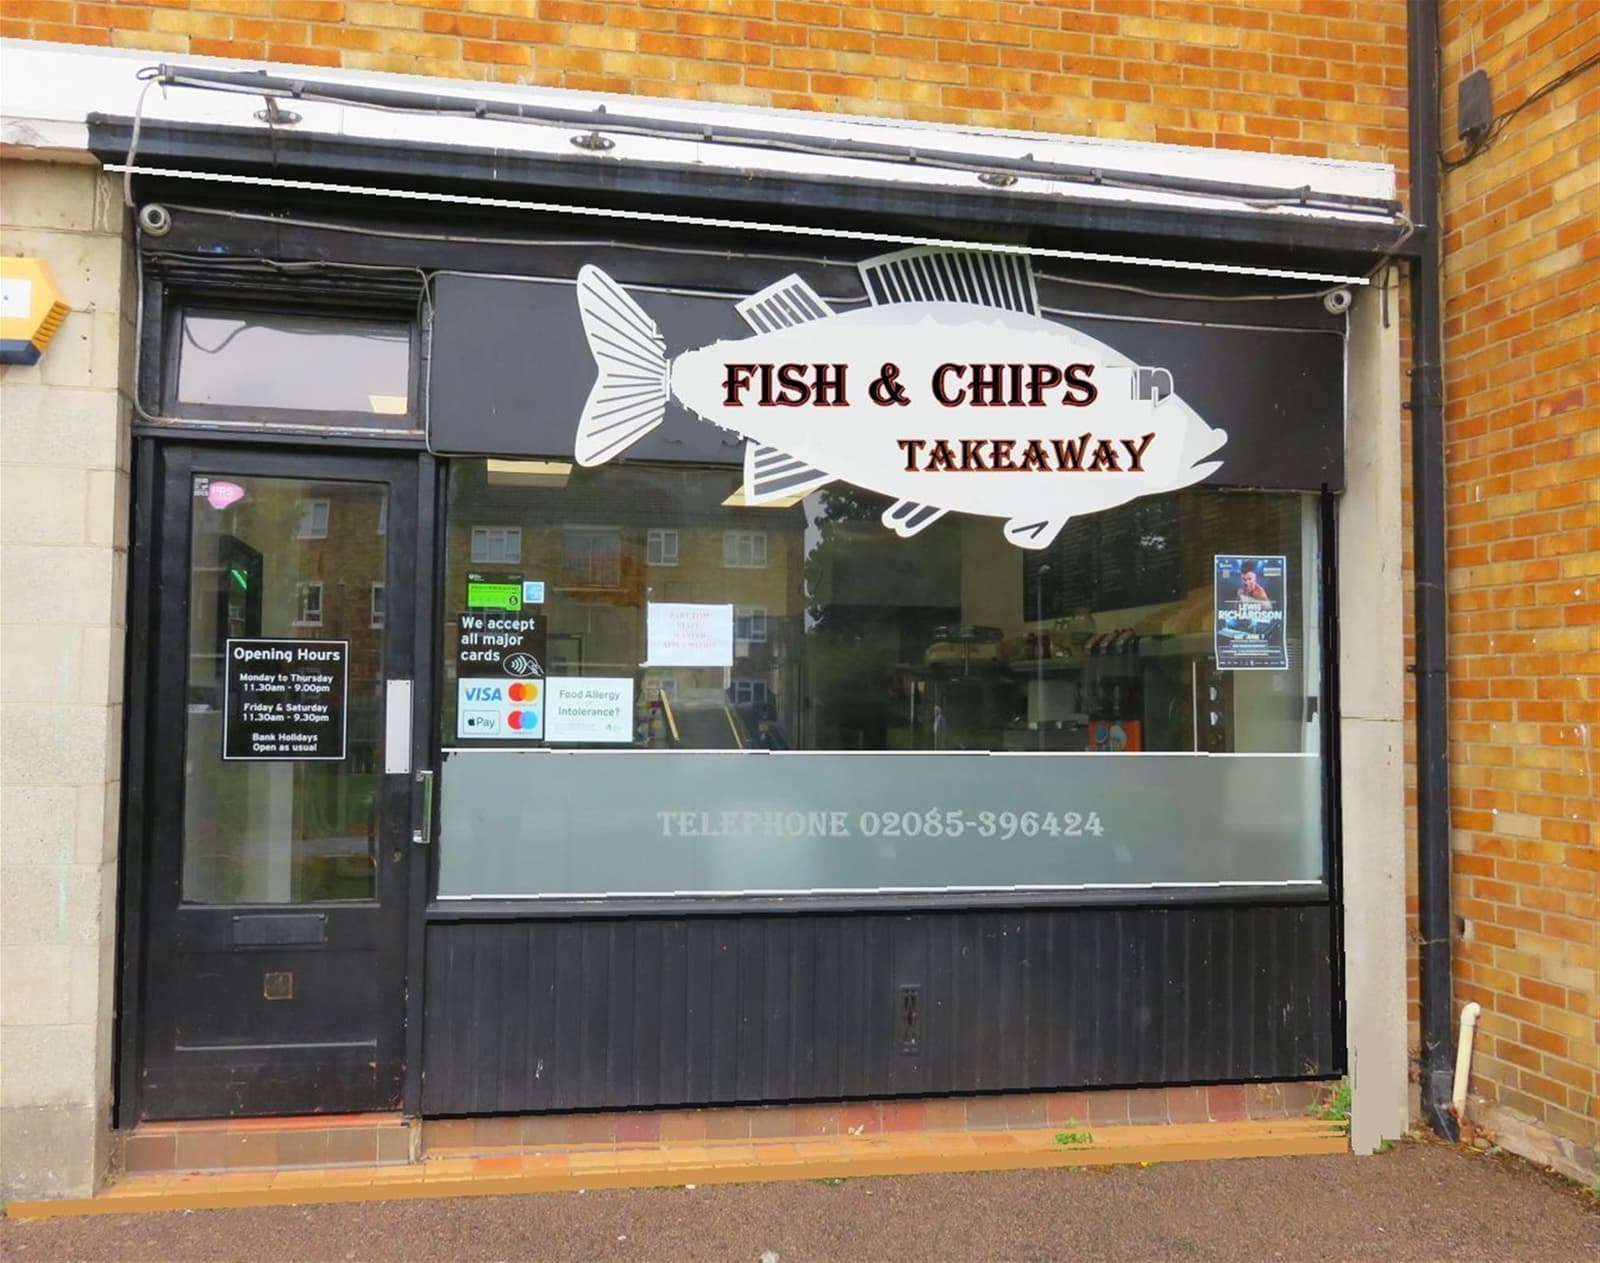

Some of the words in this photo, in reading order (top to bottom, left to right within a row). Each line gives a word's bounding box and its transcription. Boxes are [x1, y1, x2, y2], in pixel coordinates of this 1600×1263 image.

[721, 363, 850, 407] FISH
[868, 362, 912, 407] &
[931, 363, 1099, 407] CHIPS
[897, 432, 1157, 472] TAKEAWAY
[1218, 610, 1282, 620] RICHARDSON
[461, 616, 483, 629] We
[487, 618, 535, 632] accept
[461, 633, 478, 645] all
[483, 633, 524, 648] major
[234, 647, 293, 663] Opening
[297, 648, 341, 661] Hours
[461, 649, 500, 661] cards
[240, 673, 275, 682] Monday
[291, 674, 334, 684] Thursday
[244, 683, 285, 692] 11.30am
[294, 684, 330, 693] 9.00pm
[465, 687, 503, 701] VISA
[559, 690, 583, 699] Food
[586, 690, 620, 702] Allergy
[243, 703, 274, 713] Friday
[286, 703, 328, 713] Saturday
[558, 706, 621, 716] Intolerance?
[243, 713, 284, 721] 11.30am
[293, 713, 330, 723] 9.30pm
[476, 718, 495, 729] Pay
[252, 733, 276, 741] Bank
[278, 733, 318, 743] Holidays
[252, 743, 276, 752] Open
[292, 743, 317, 751] usual
[656, 811, 849, 837] TELEPHONE
[860, 807, 1105, 840] 02085-396424
